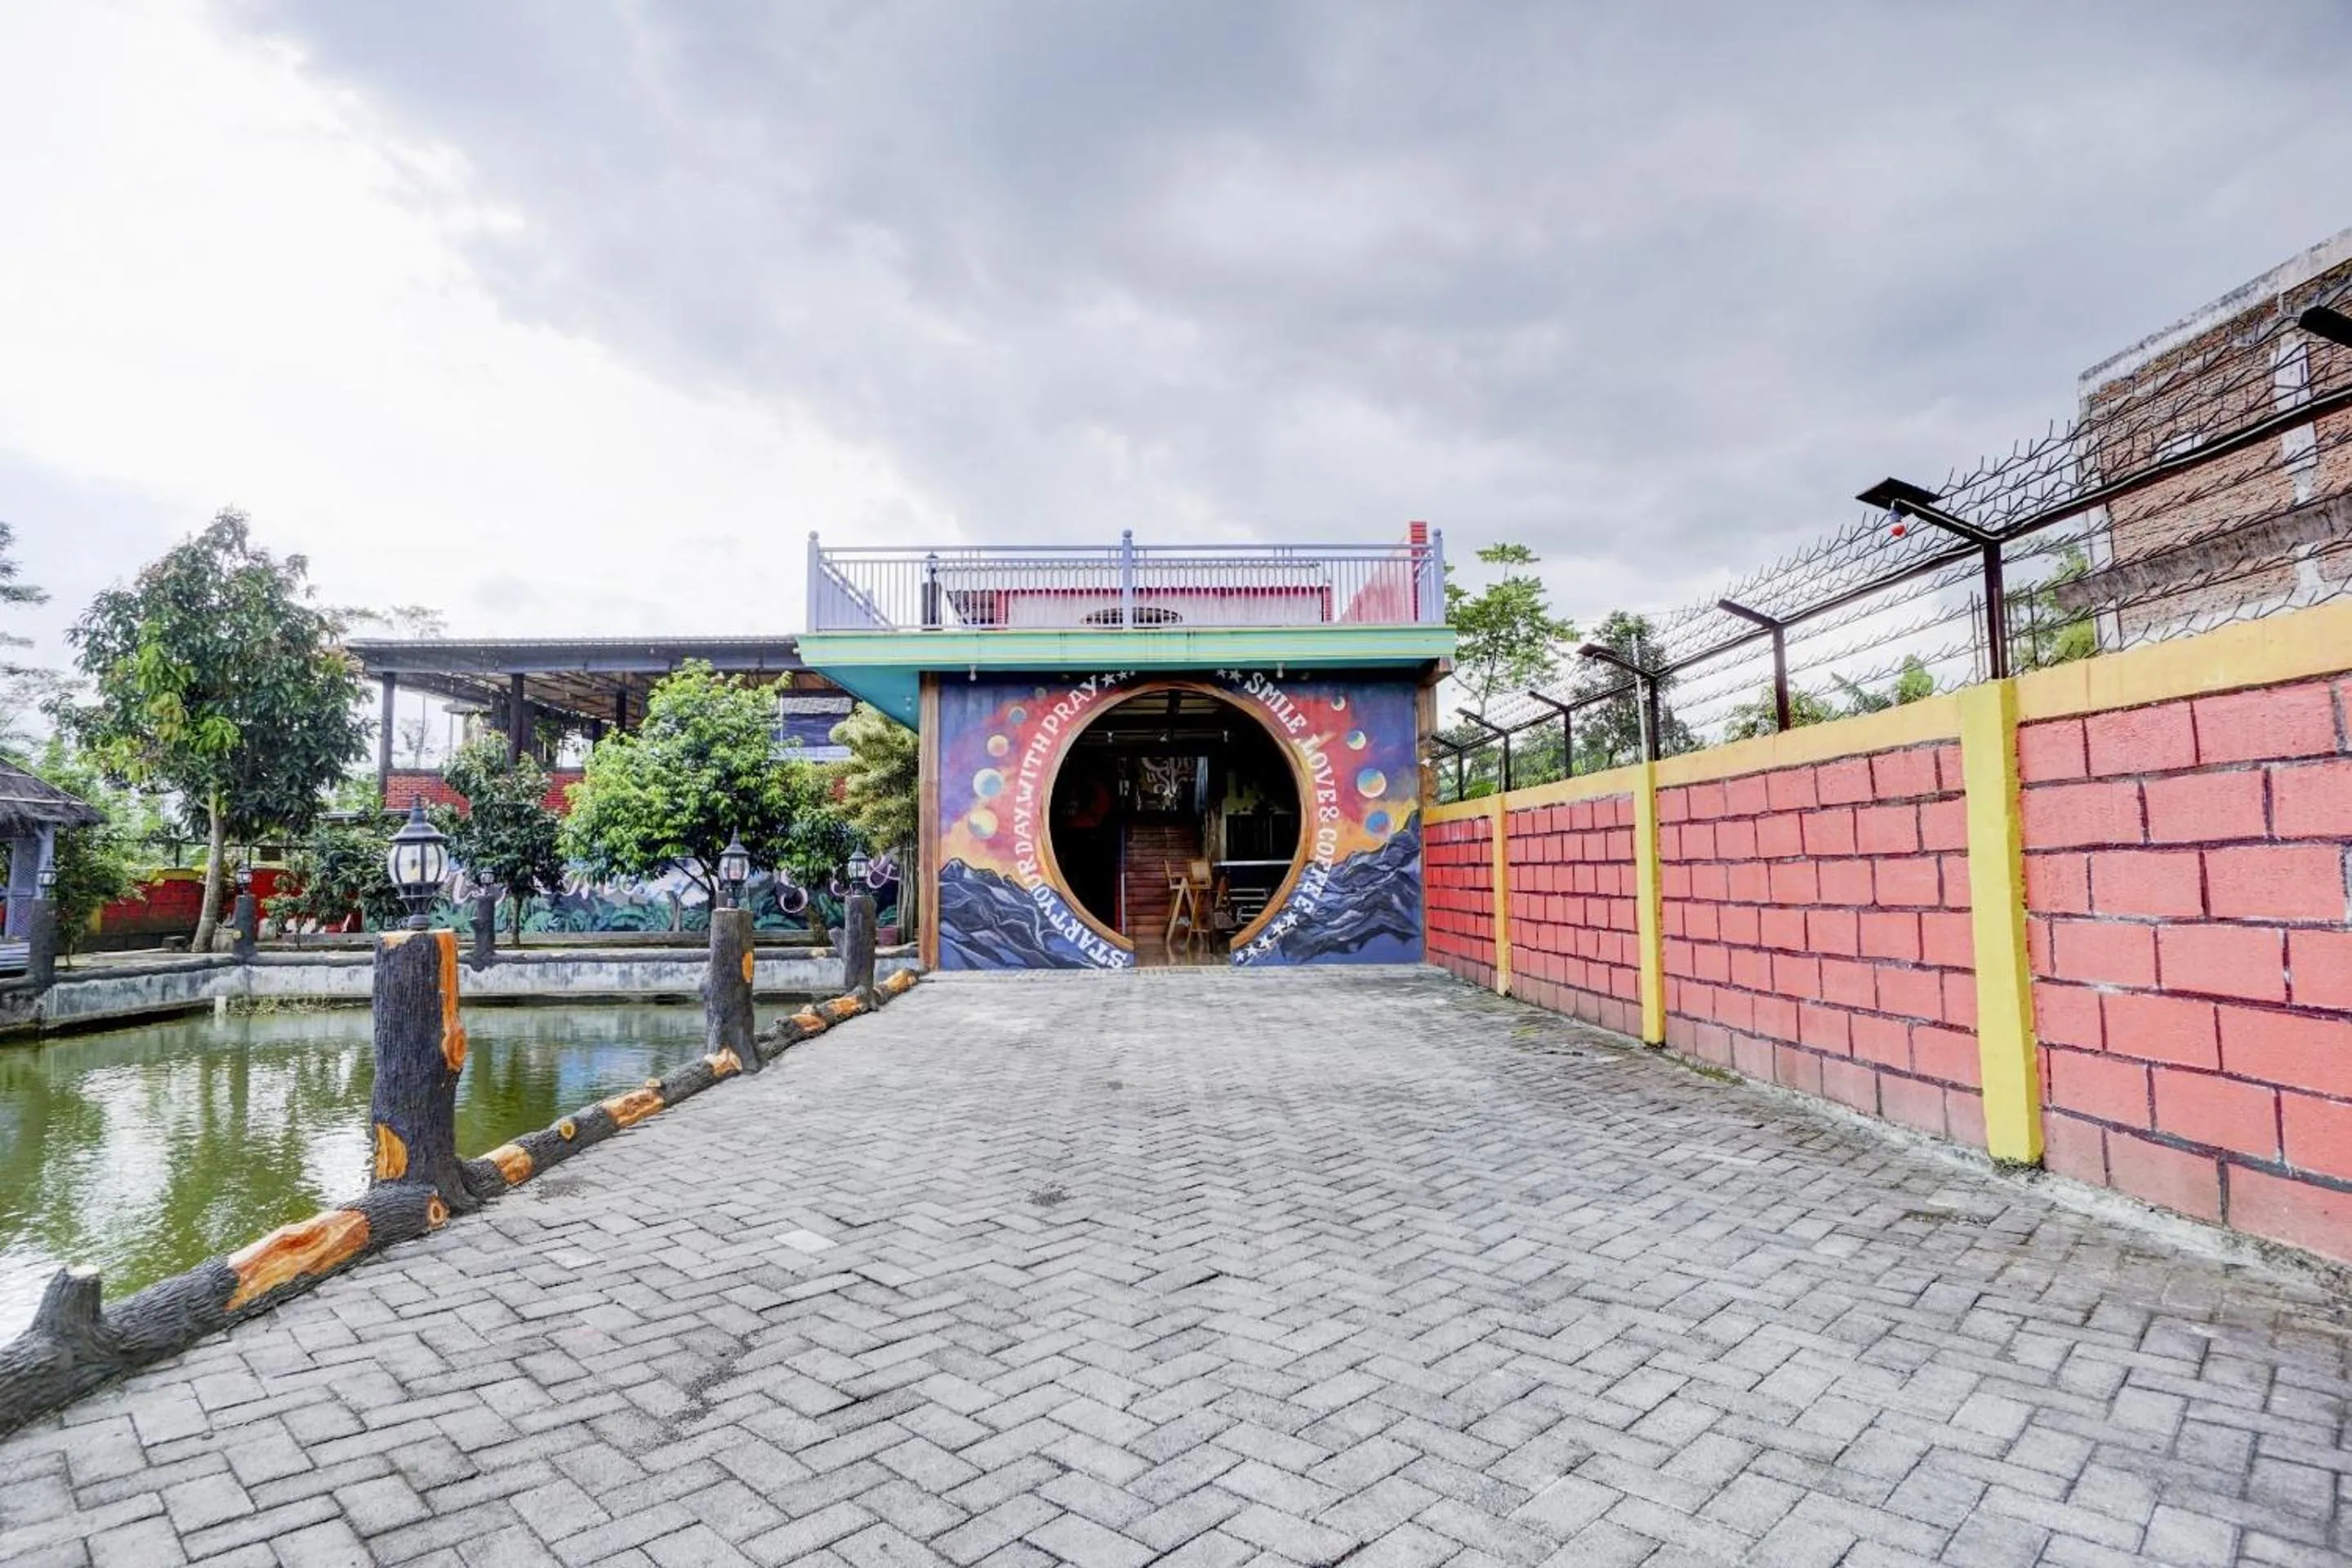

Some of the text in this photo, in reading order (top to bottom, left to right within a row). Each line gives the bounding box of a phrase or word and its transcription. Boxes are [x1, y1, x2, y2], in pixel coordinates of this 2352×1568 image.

[1041, 675, 1097, 736] PRAY
[1016, 732, 1052, 803] WITH
[1300, 733, 1336, 804] LOVE
[1319, 806, 1339, 823] &
[1018, 854, 1057, 916] YOUR
[1294, 827, 1338, 914] COFFEE
[1049, 911, 1128, 969] START
